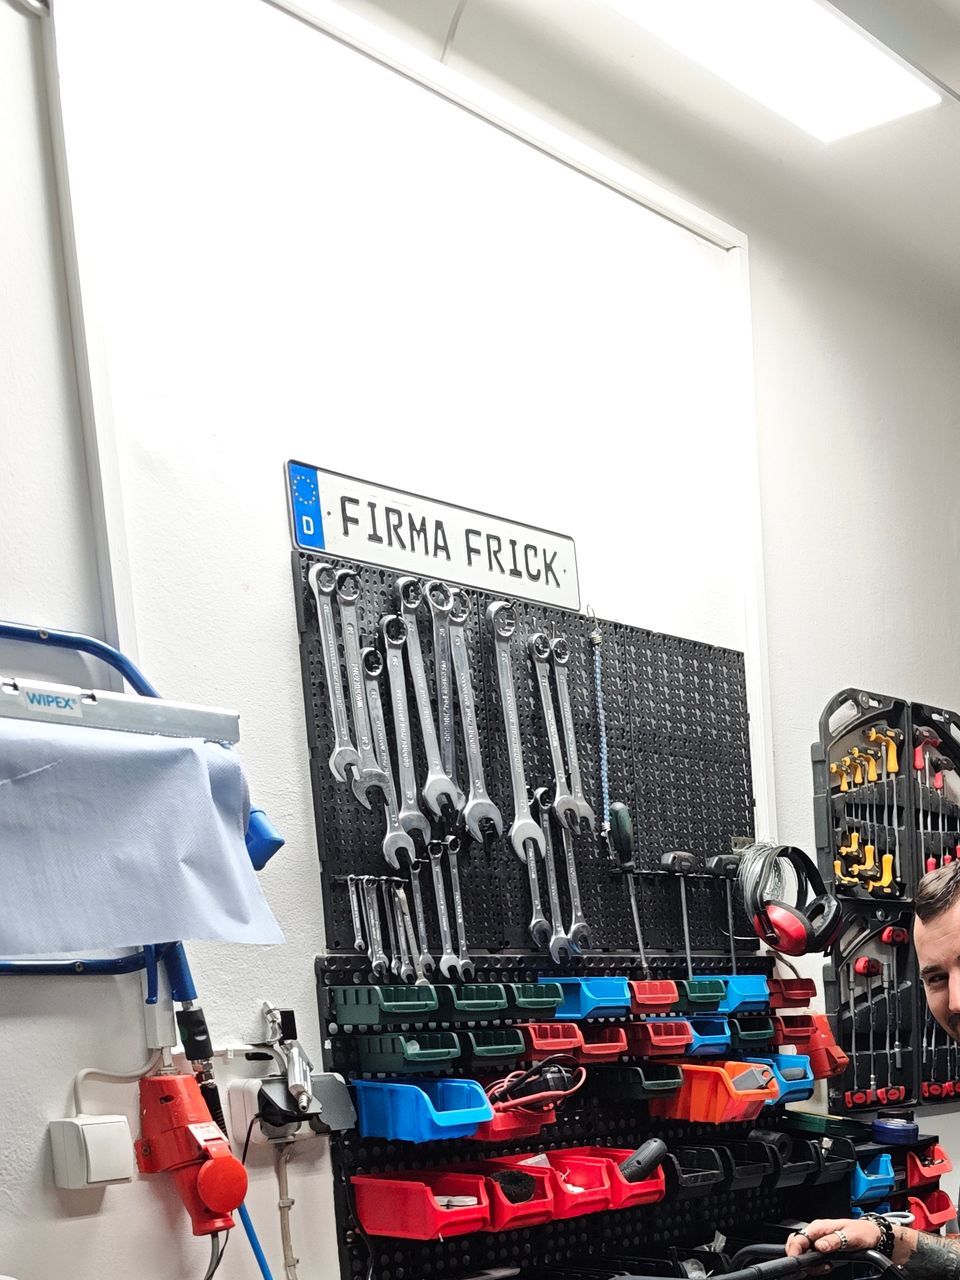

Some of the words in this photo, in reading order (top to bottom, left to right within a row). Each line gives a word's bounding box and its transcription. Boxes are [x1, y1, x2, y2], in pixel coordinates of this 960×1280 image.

[302, 515, 314, 535] D
[340, 495, 451, 561] FIRMA
[465, 529, 561, 588] FRICK
